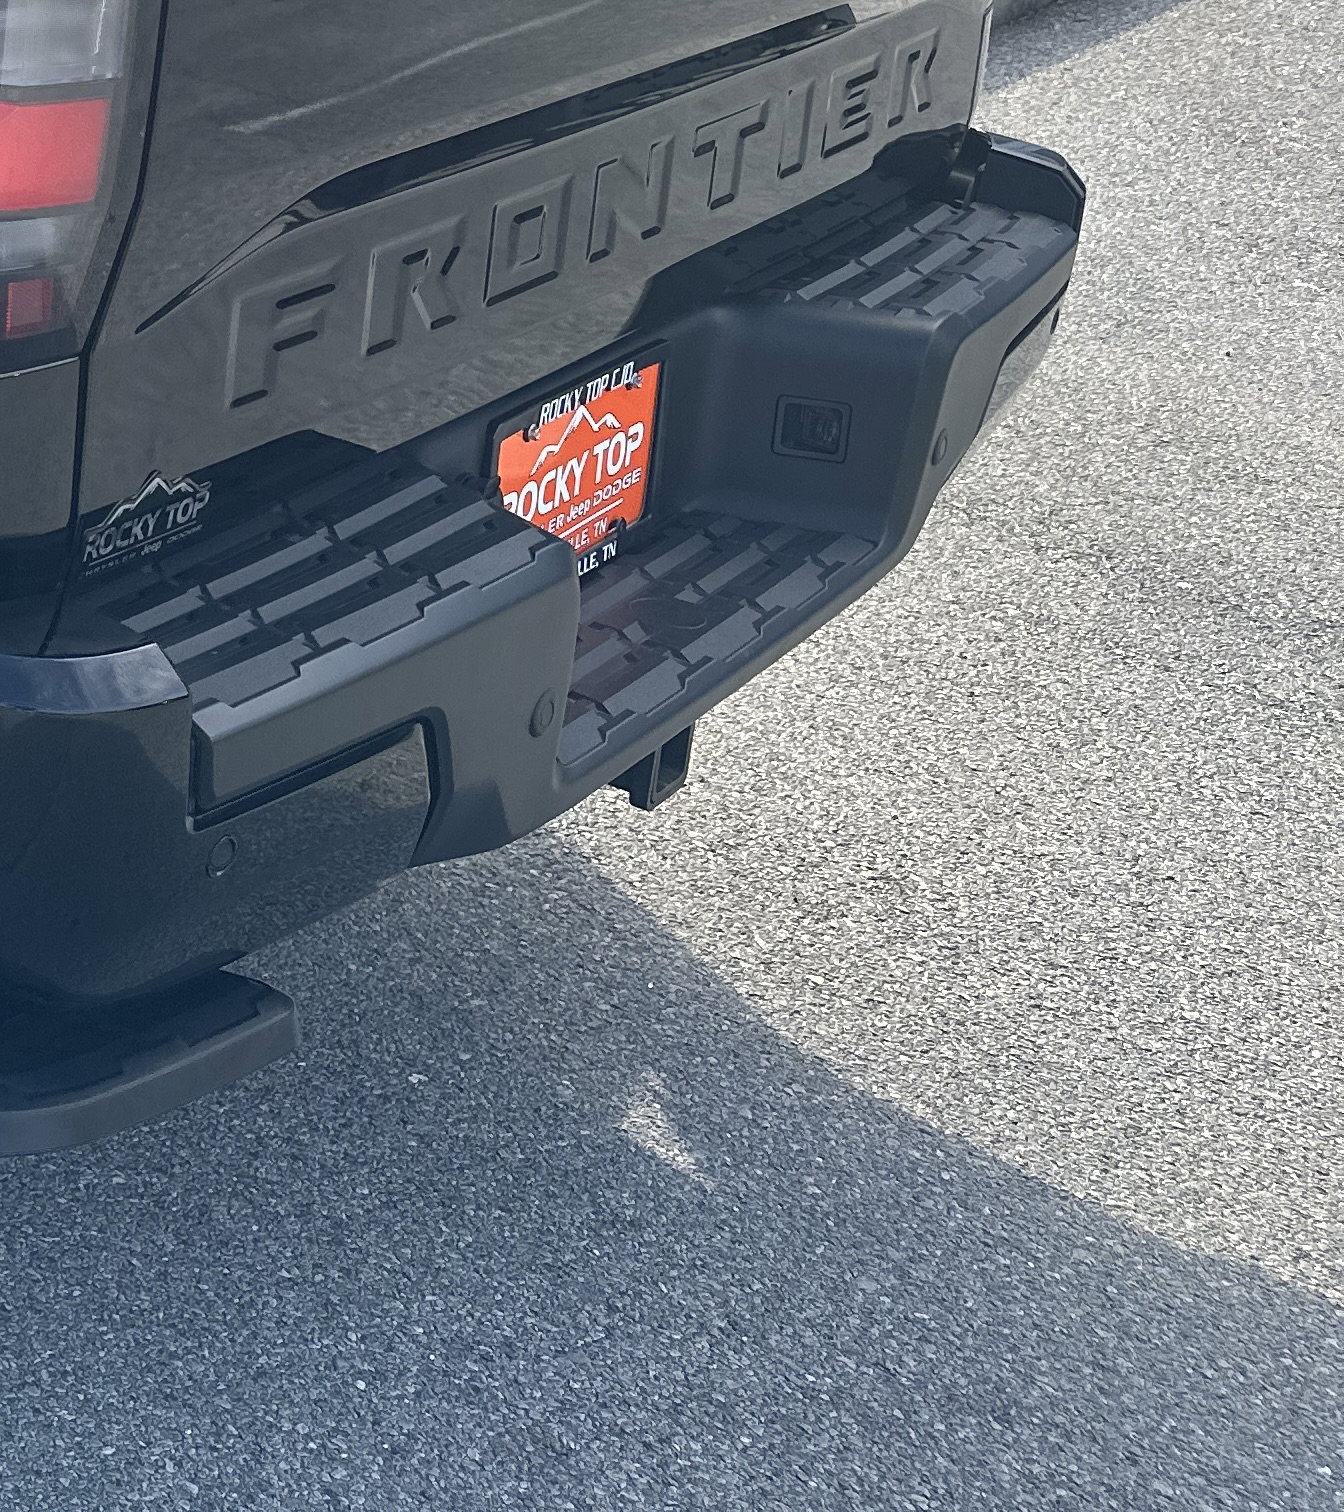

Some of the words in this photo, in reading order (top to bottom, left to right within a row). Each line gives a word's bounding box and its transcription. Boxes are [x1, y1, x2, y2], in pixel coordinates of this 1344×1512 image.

[224, 27, 941, 411] FRONTIER
[538, 386, 583, 428] ROCKY
[585, 374, 610, 404] TOP
[593, 421, 645, 484] TOP
[566, 497, 591, 523] Jeep
[592, 467, 642, 507] DODGE
[82, 508, 162, 563] ROCKY
[165, 490, 210, 529] TOP
[602, 540, 617, 561] TN
